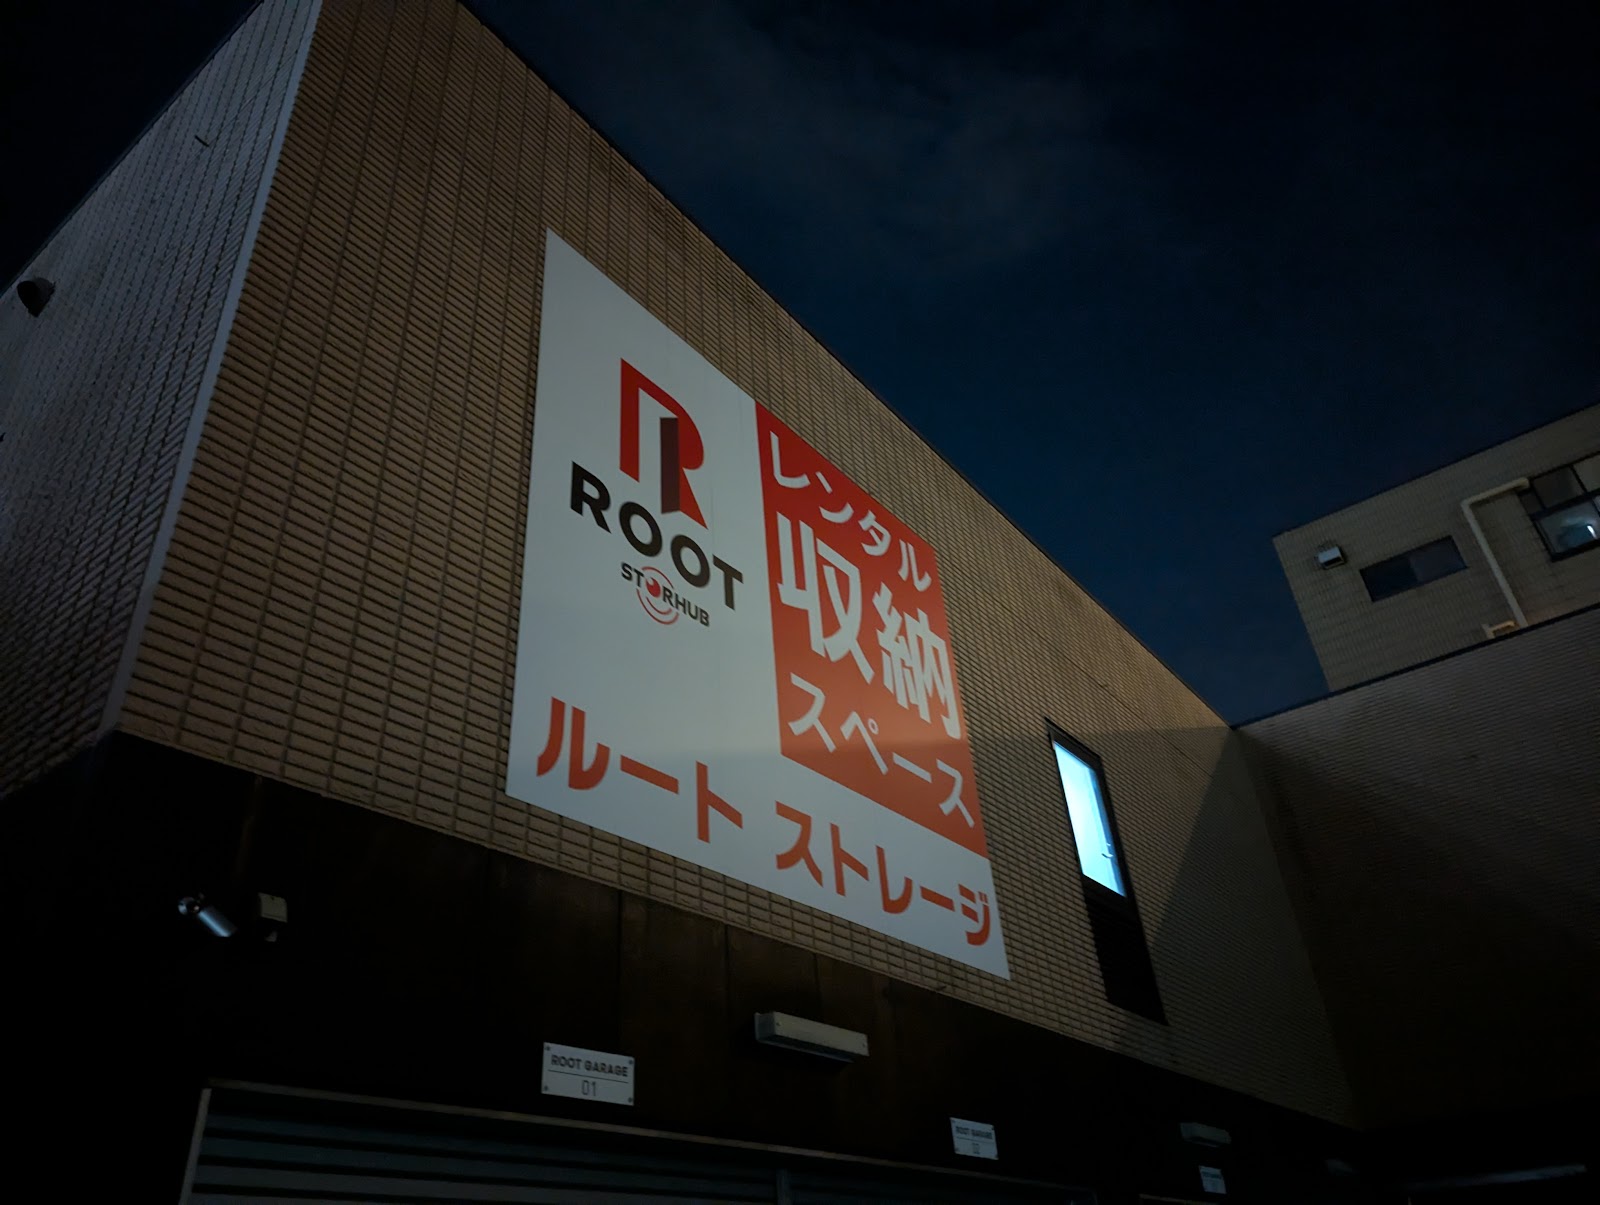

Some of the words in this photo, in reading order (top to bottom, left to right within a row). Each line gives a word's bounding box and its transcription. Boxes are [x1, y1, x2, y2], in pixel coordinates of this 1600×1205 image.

[570, 460, 743, 611] ROOT
[770, 432, 932, 590] レンタル
[776, 511, 961, 740] 収納
[536, 696, 743, 843] ルート
[775, 800, 991, 946] ストレージ
[788, 673, 975, 829] スペース
[551, 1054, 581, 1070] ROOT
[584, 1060, 629, 1078] GARAGE
[581, 1080, 597, 1097] 01
